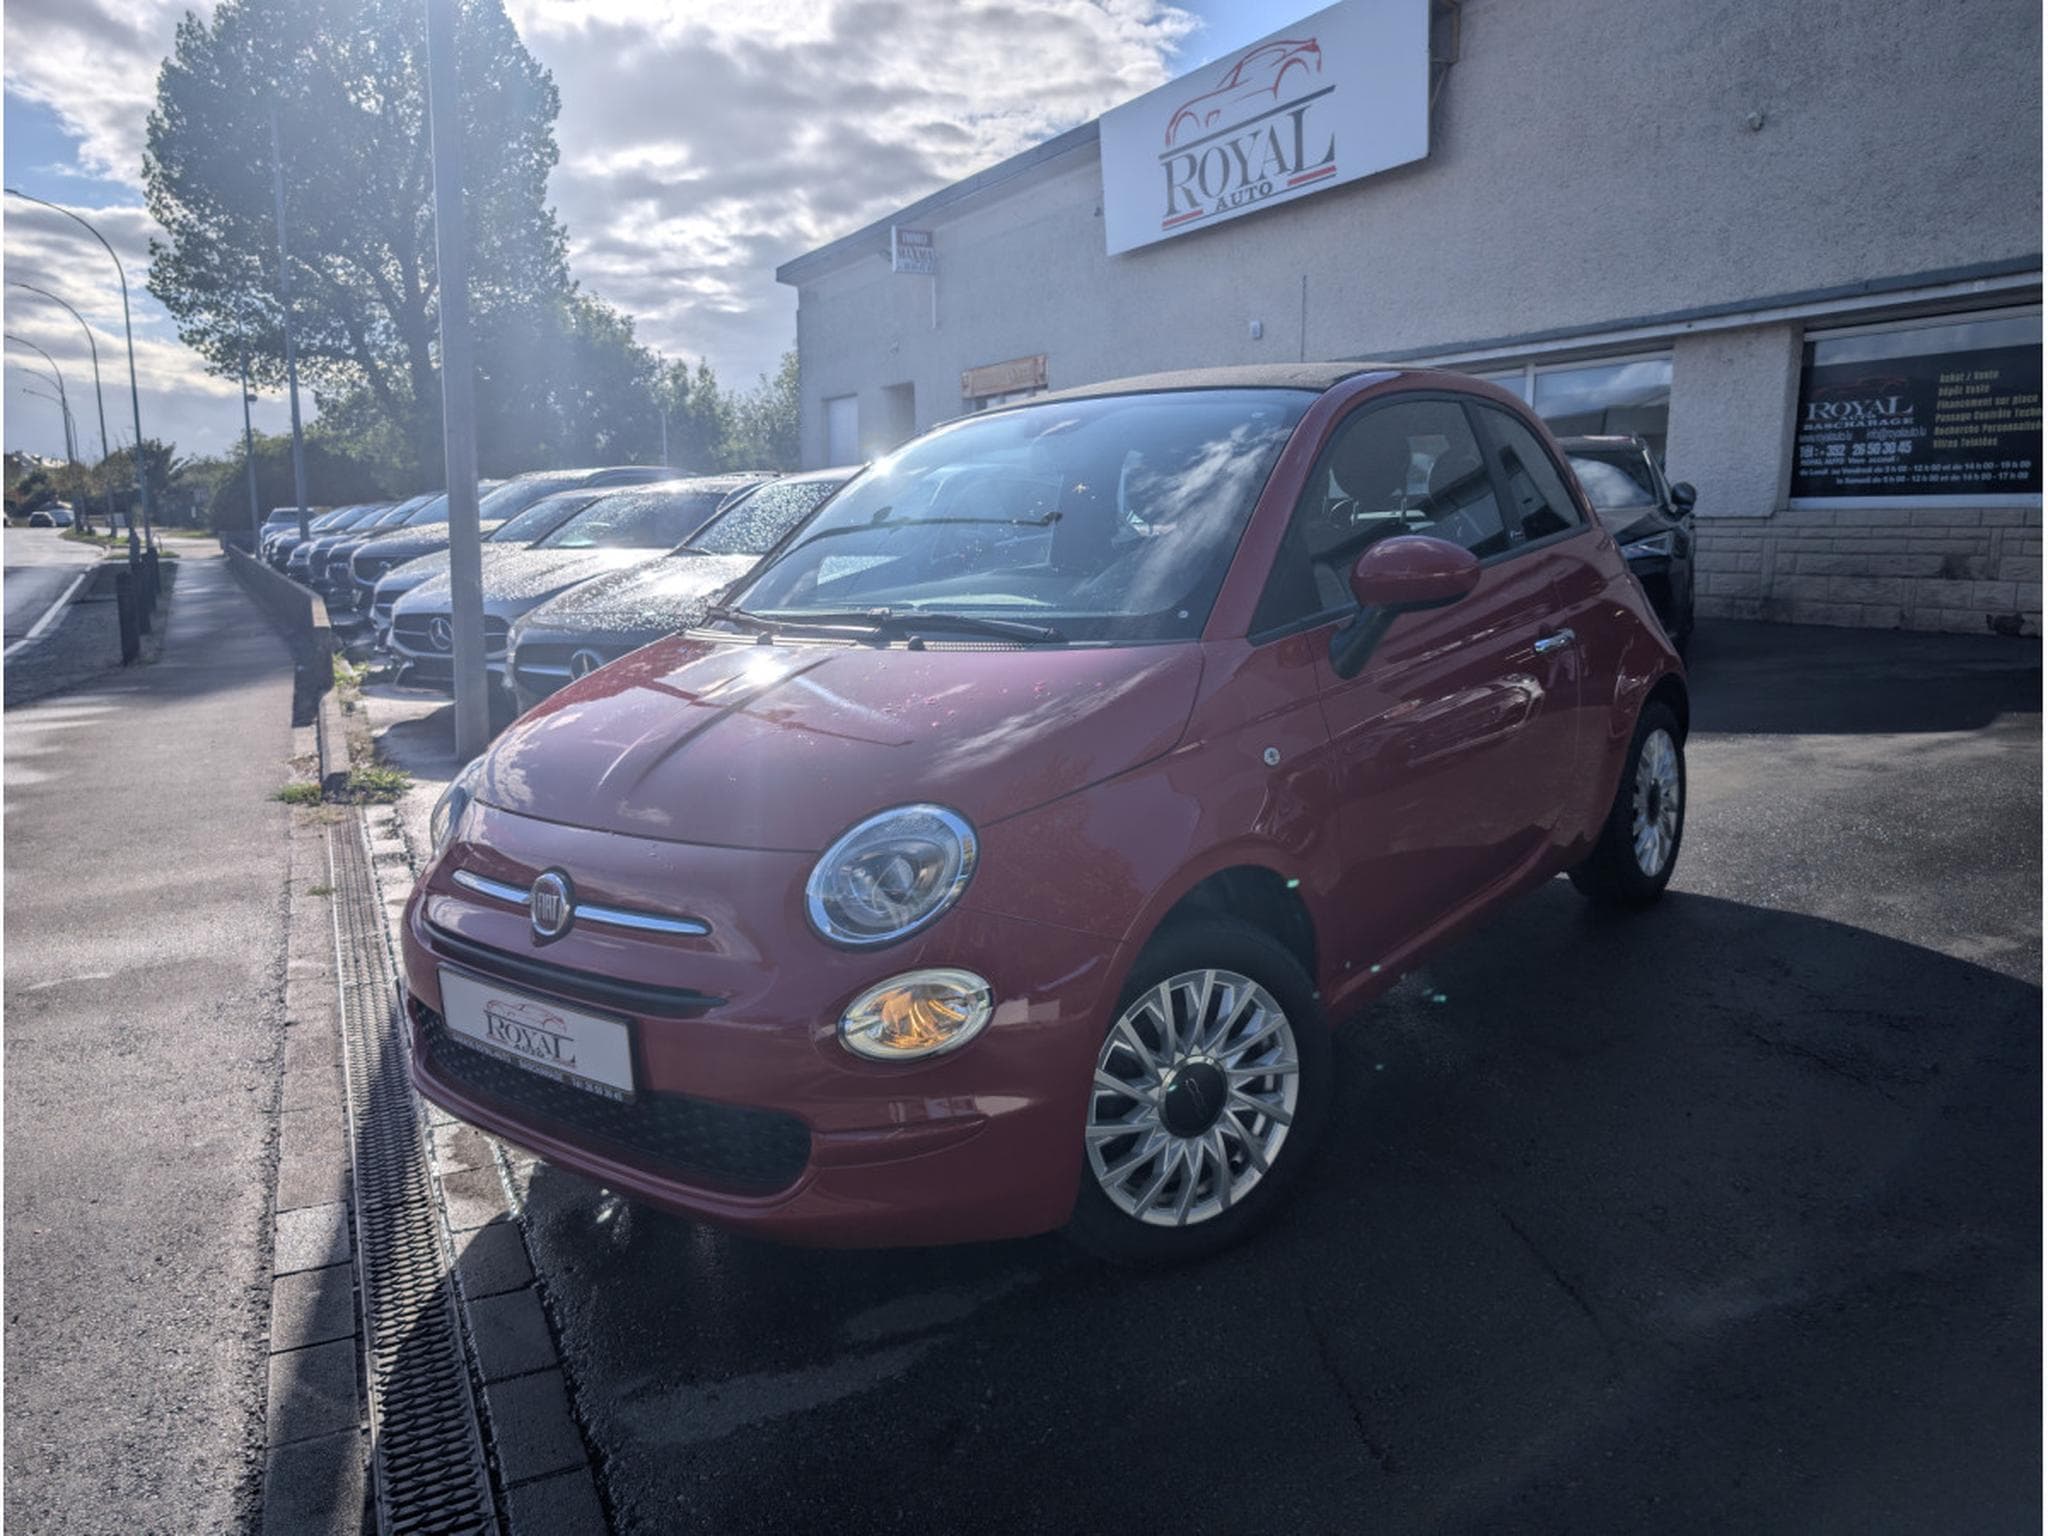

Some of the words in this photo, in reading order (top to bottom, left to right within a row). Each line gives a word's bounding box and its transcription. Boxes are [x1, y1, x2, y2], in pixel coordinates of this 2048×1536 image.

[1161, 104, 1336, 218] ROYAL
[1215, 181, 1273, 213] AUTO
[1803, 416, 1914, 431] BASCHARAGE
[1807, 396, 1914, 420] ROYAL
[536, 891, 560, 921] FIAT
[485, 1012, 577, 1064] ROYAL
